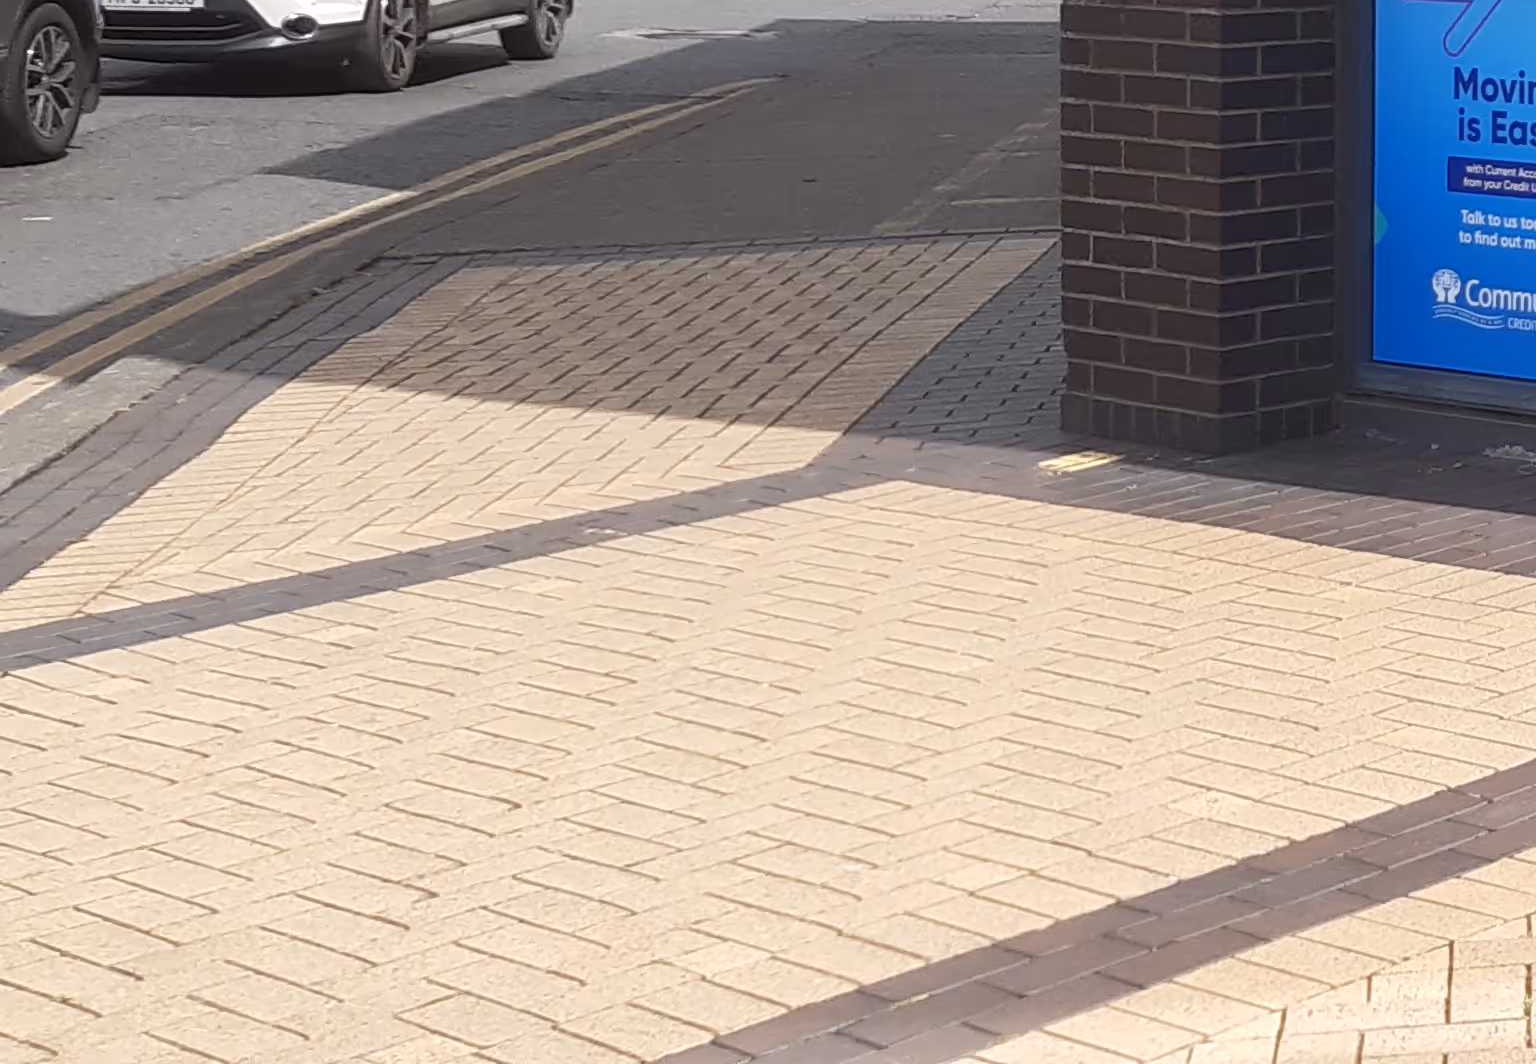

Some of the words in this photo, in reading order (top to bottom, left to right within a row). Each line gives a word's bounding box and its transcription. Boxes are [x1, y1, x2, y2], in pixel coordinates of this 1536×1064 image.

[1459, 107, 1481, 142] is
[1466, 163, 1484, 175] with
[1485, 164, 1516, 178] Current
[1463, 176, 1482, 188] from
[1483, 179, 1502, 191] your
[1504, 179, 1529, 192] Credit
[1460, 209, 1485, 225] Talk
[1488, 213, 1501, 227] to
[1503, 216, 1517, 228] us
[1458, 230, 1472, 244] to
[1474, 230, 1498, 247] find
[1500, 234, 1521, 249] out
